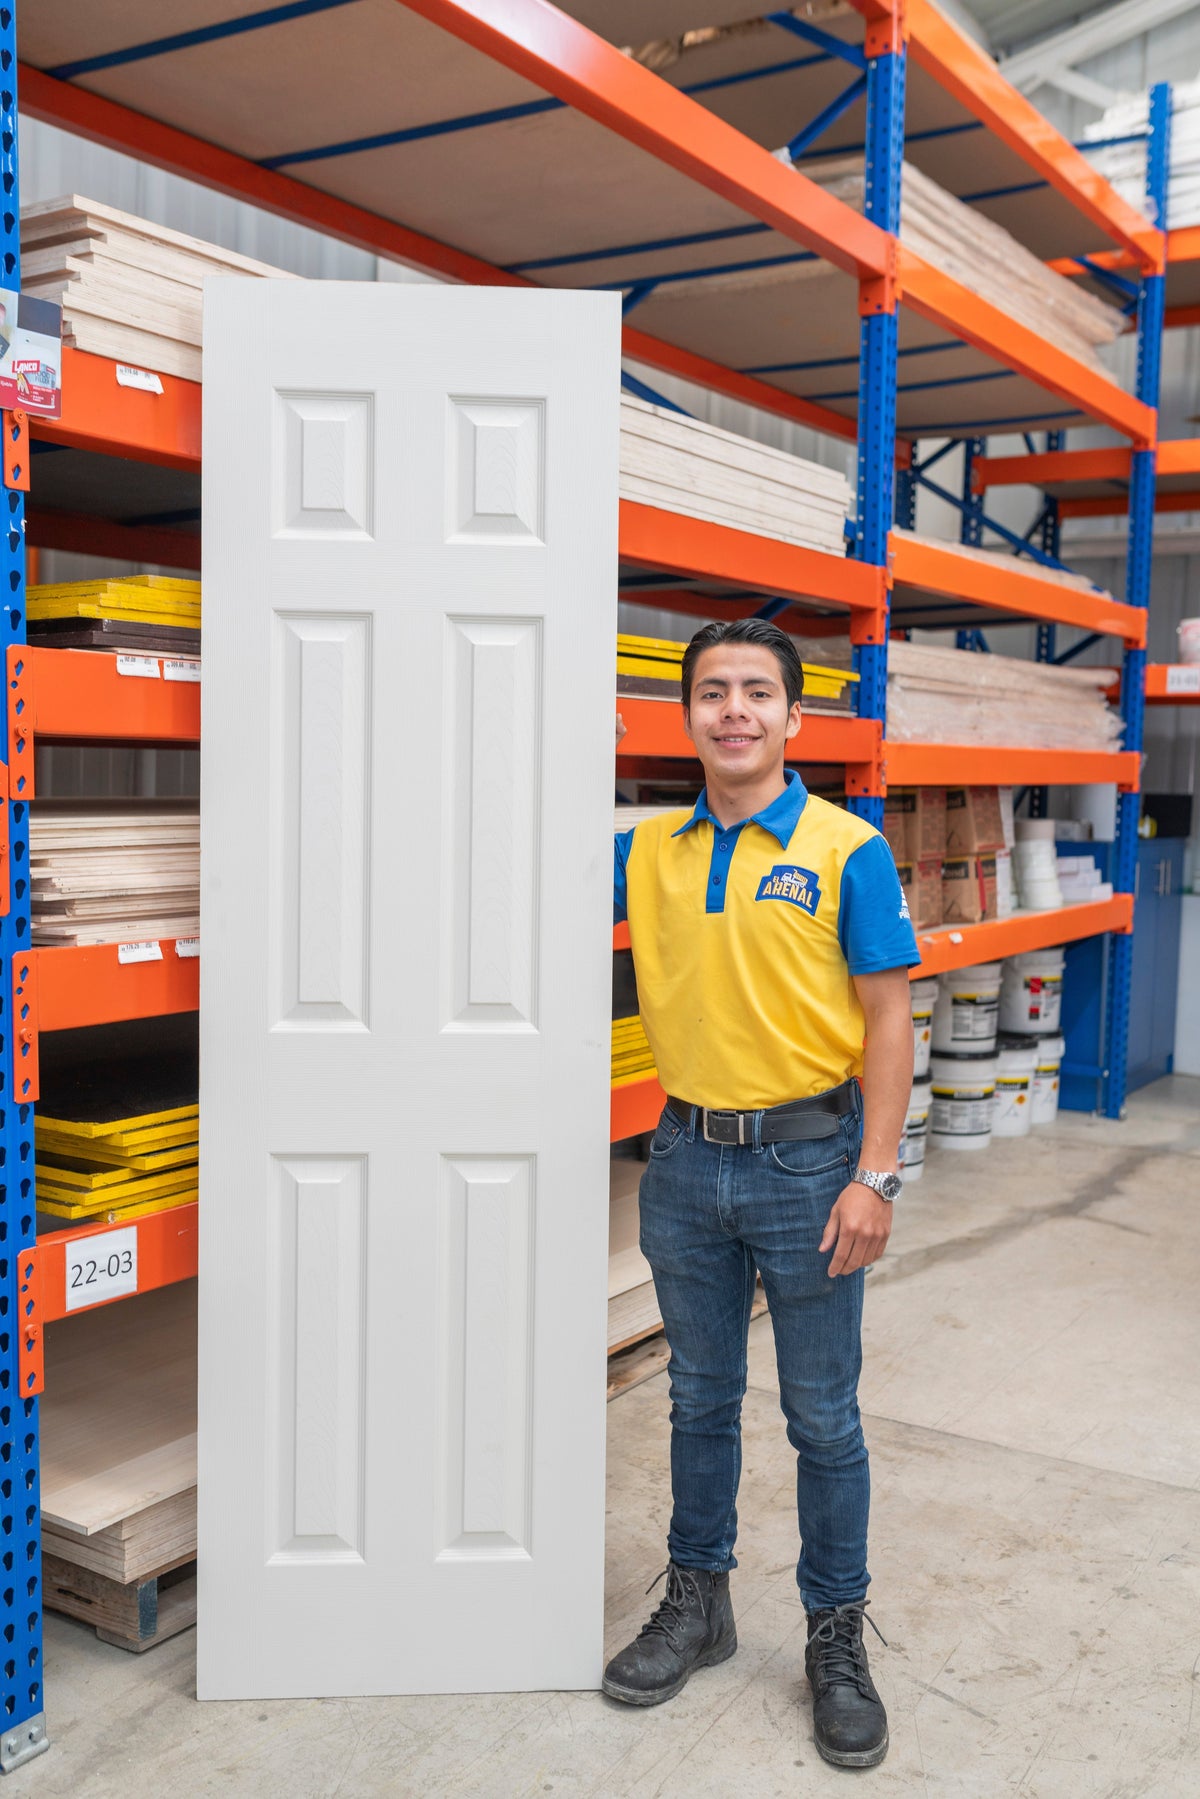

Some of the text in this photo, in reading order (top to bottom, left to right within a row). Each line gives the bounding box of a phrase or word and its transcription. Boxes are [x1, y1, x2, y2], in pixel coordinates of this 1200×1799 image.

[772, 875, 780, 884] EL
[762, 881, 813, 908] ARENAL
[71, 1250, 133, 1288] 22-03
